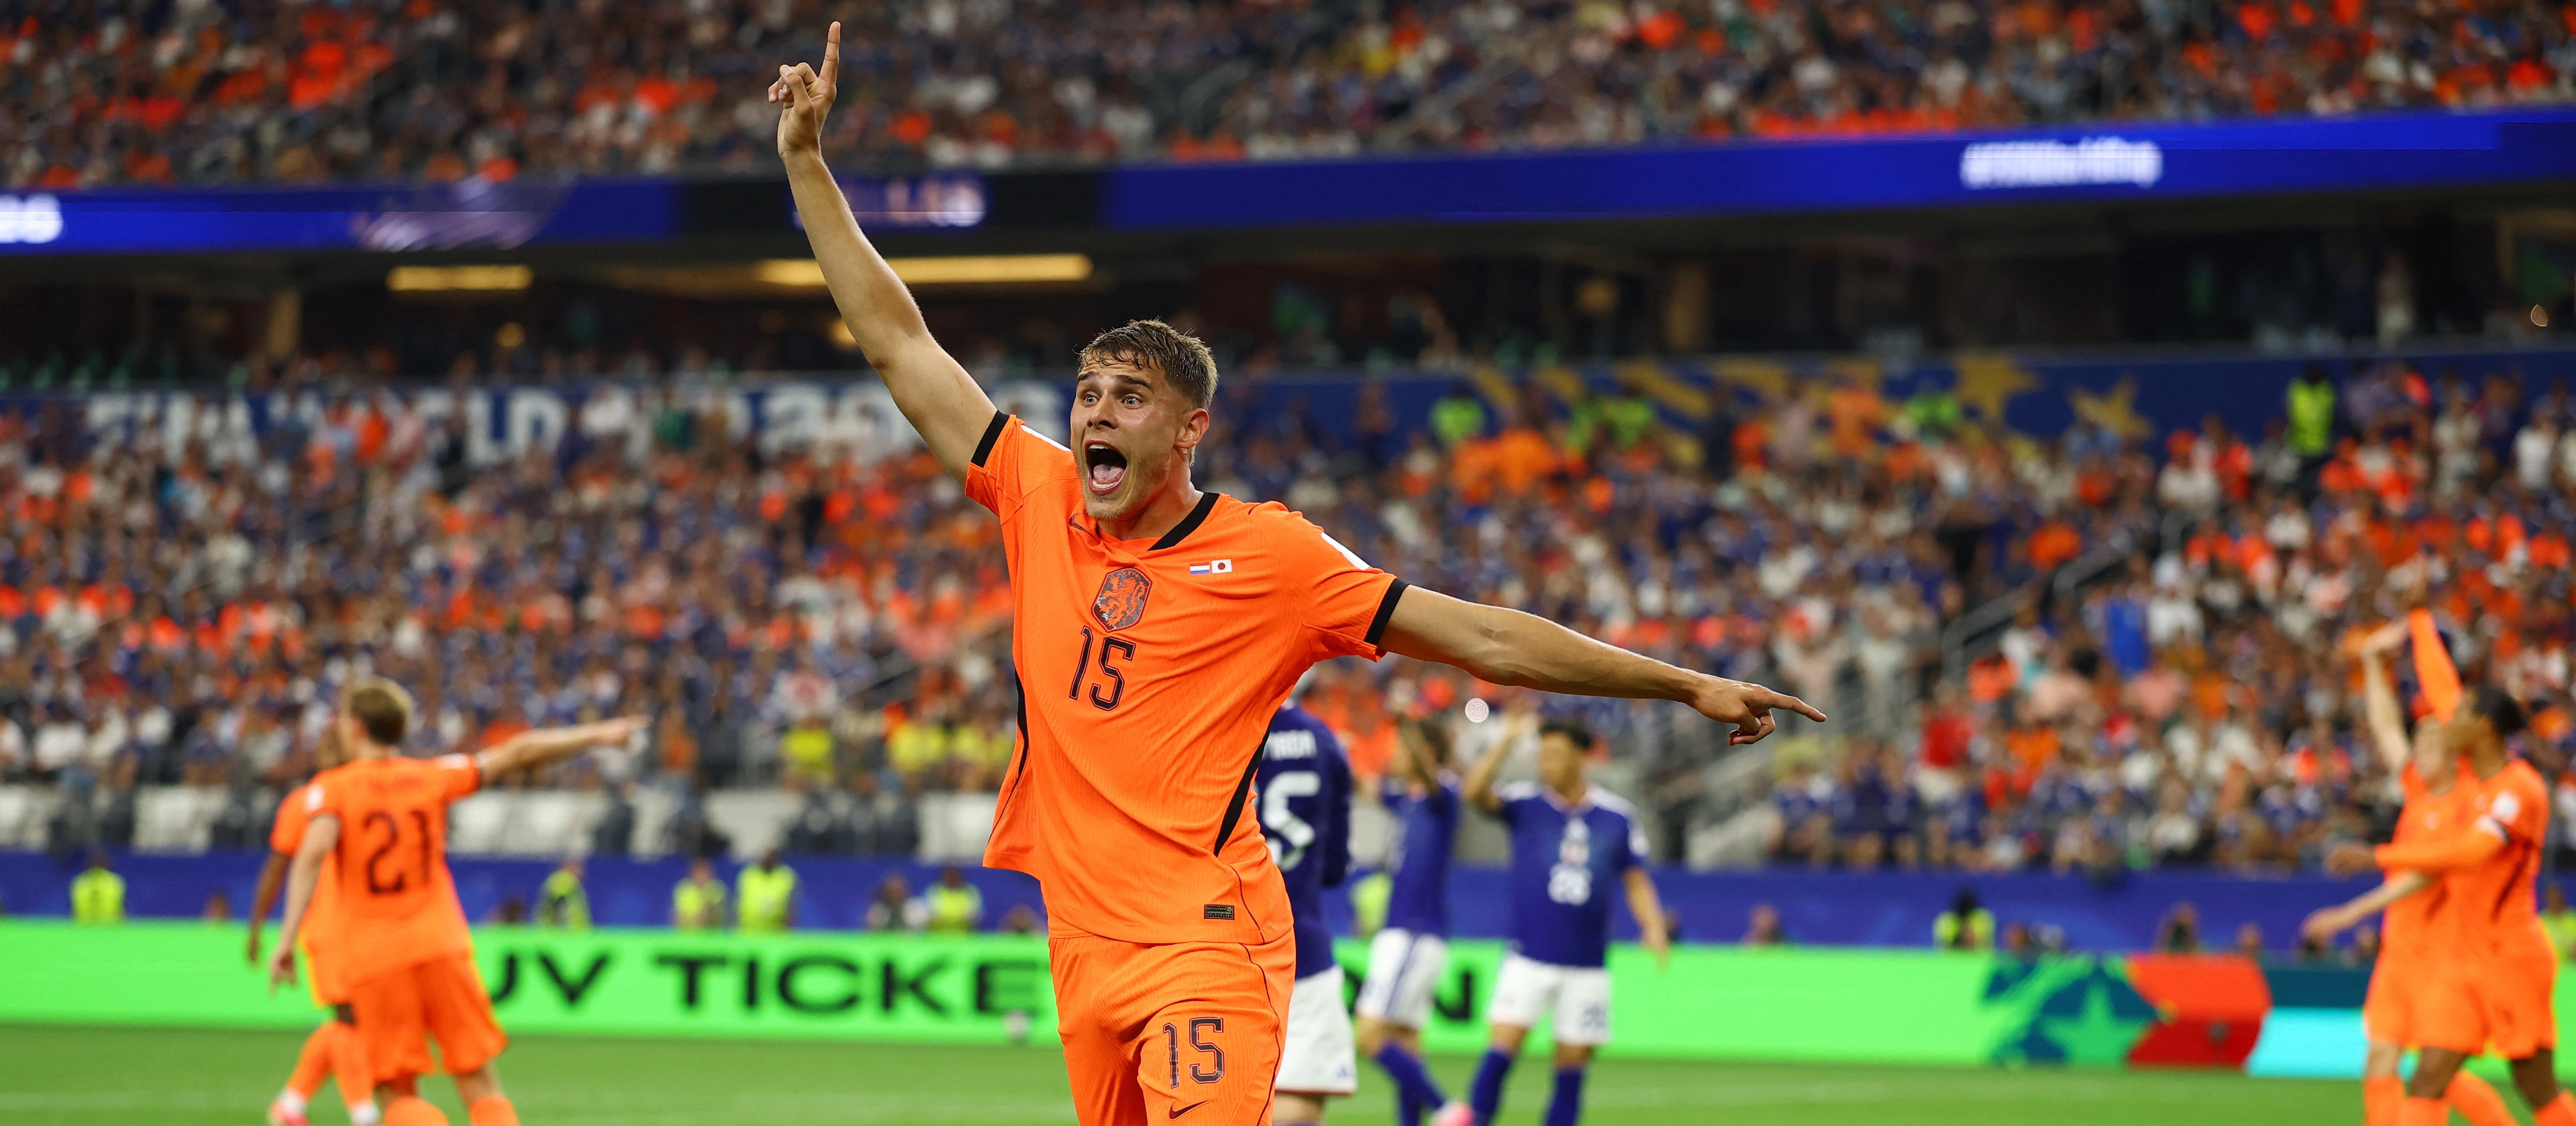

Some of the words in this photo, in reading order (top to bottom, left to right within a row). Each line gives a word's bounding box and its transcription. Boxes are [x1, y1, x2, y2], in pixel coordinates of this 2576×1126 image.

[1070, 626, 1136, 711] 15
[363, 809, 432, 897] 21
[1252, 771, 1321, 872] 5
[654, 954, 1043, 1018] TICKE
[1163, 1016, 1224, 1089] 15
